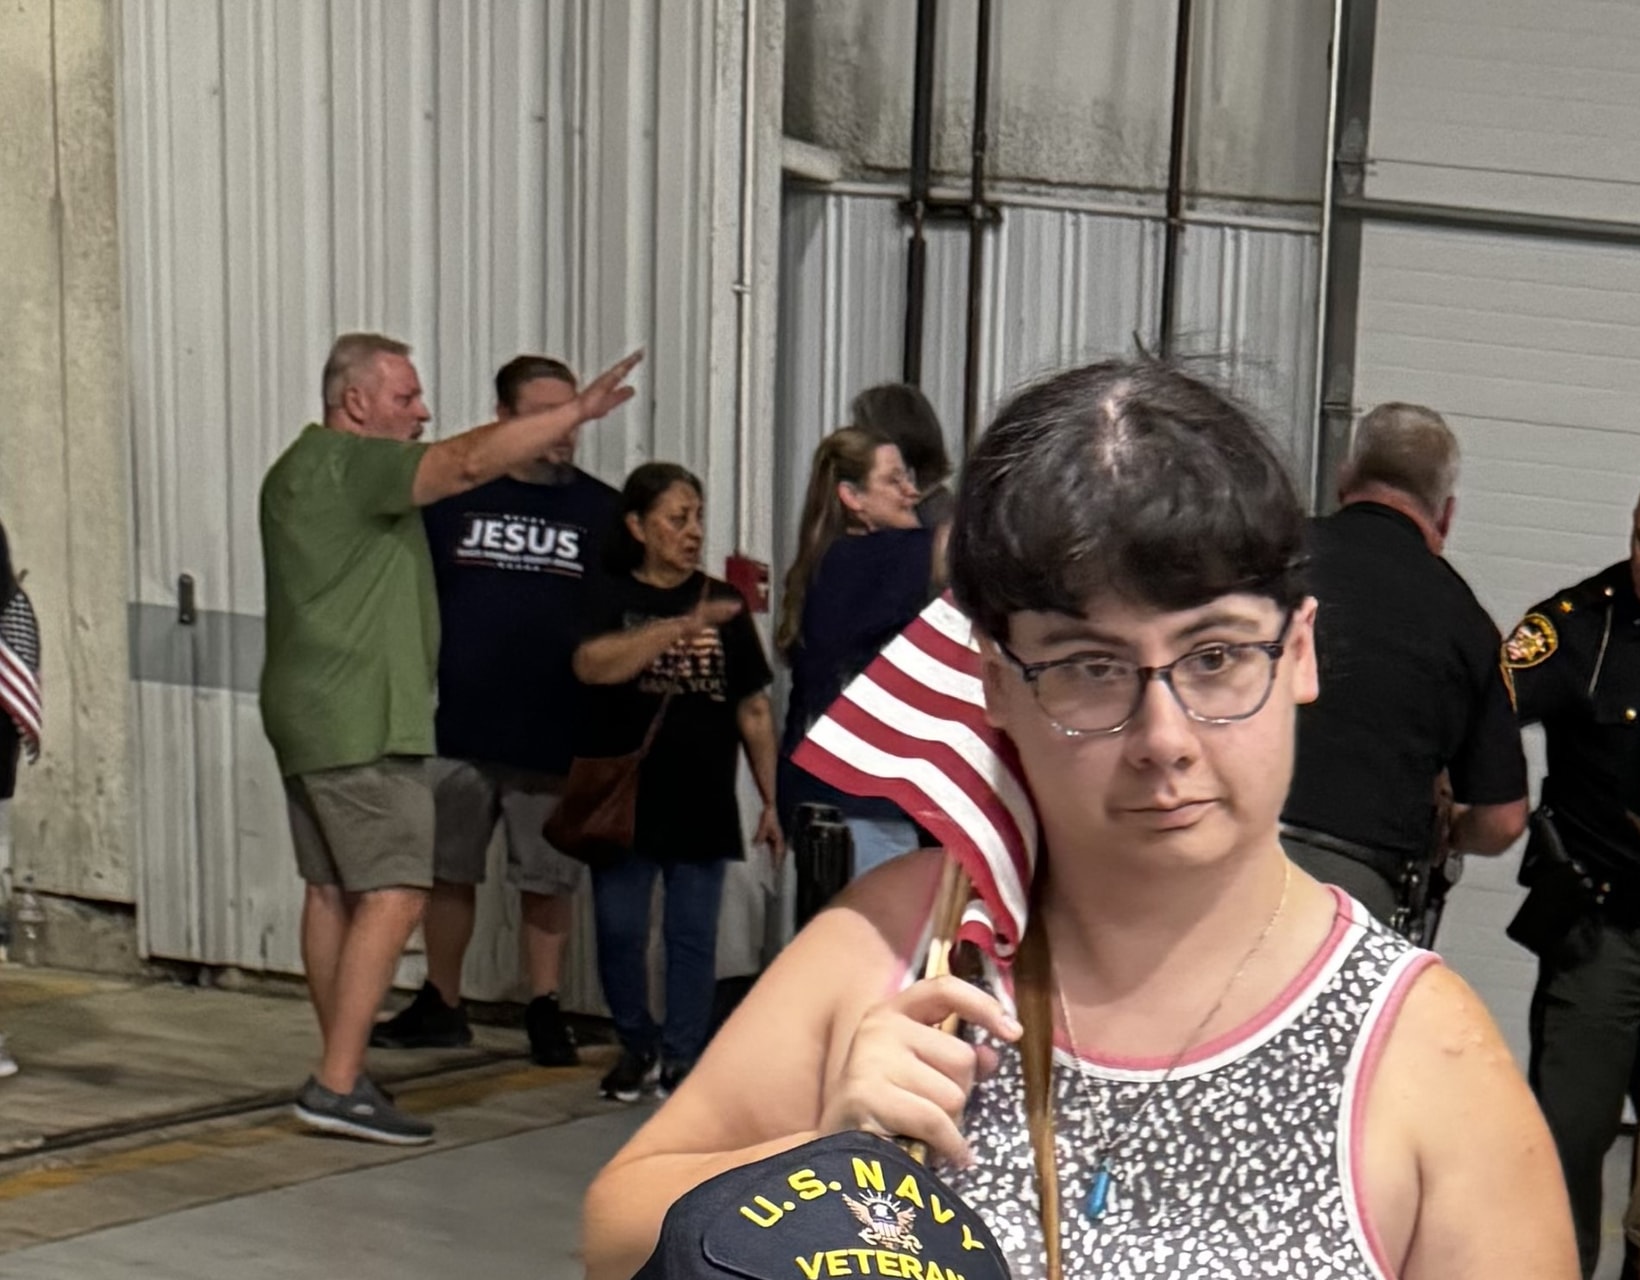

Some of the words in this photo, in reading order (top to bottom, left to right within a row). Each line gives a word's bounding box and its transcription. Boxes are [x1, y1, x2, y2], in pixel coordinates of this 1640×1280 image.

[462, 519, 579, 559] JESUS
[740, 1168, 842, 1228] U.S.
[851, 1157, 985, 1251] NAVY
